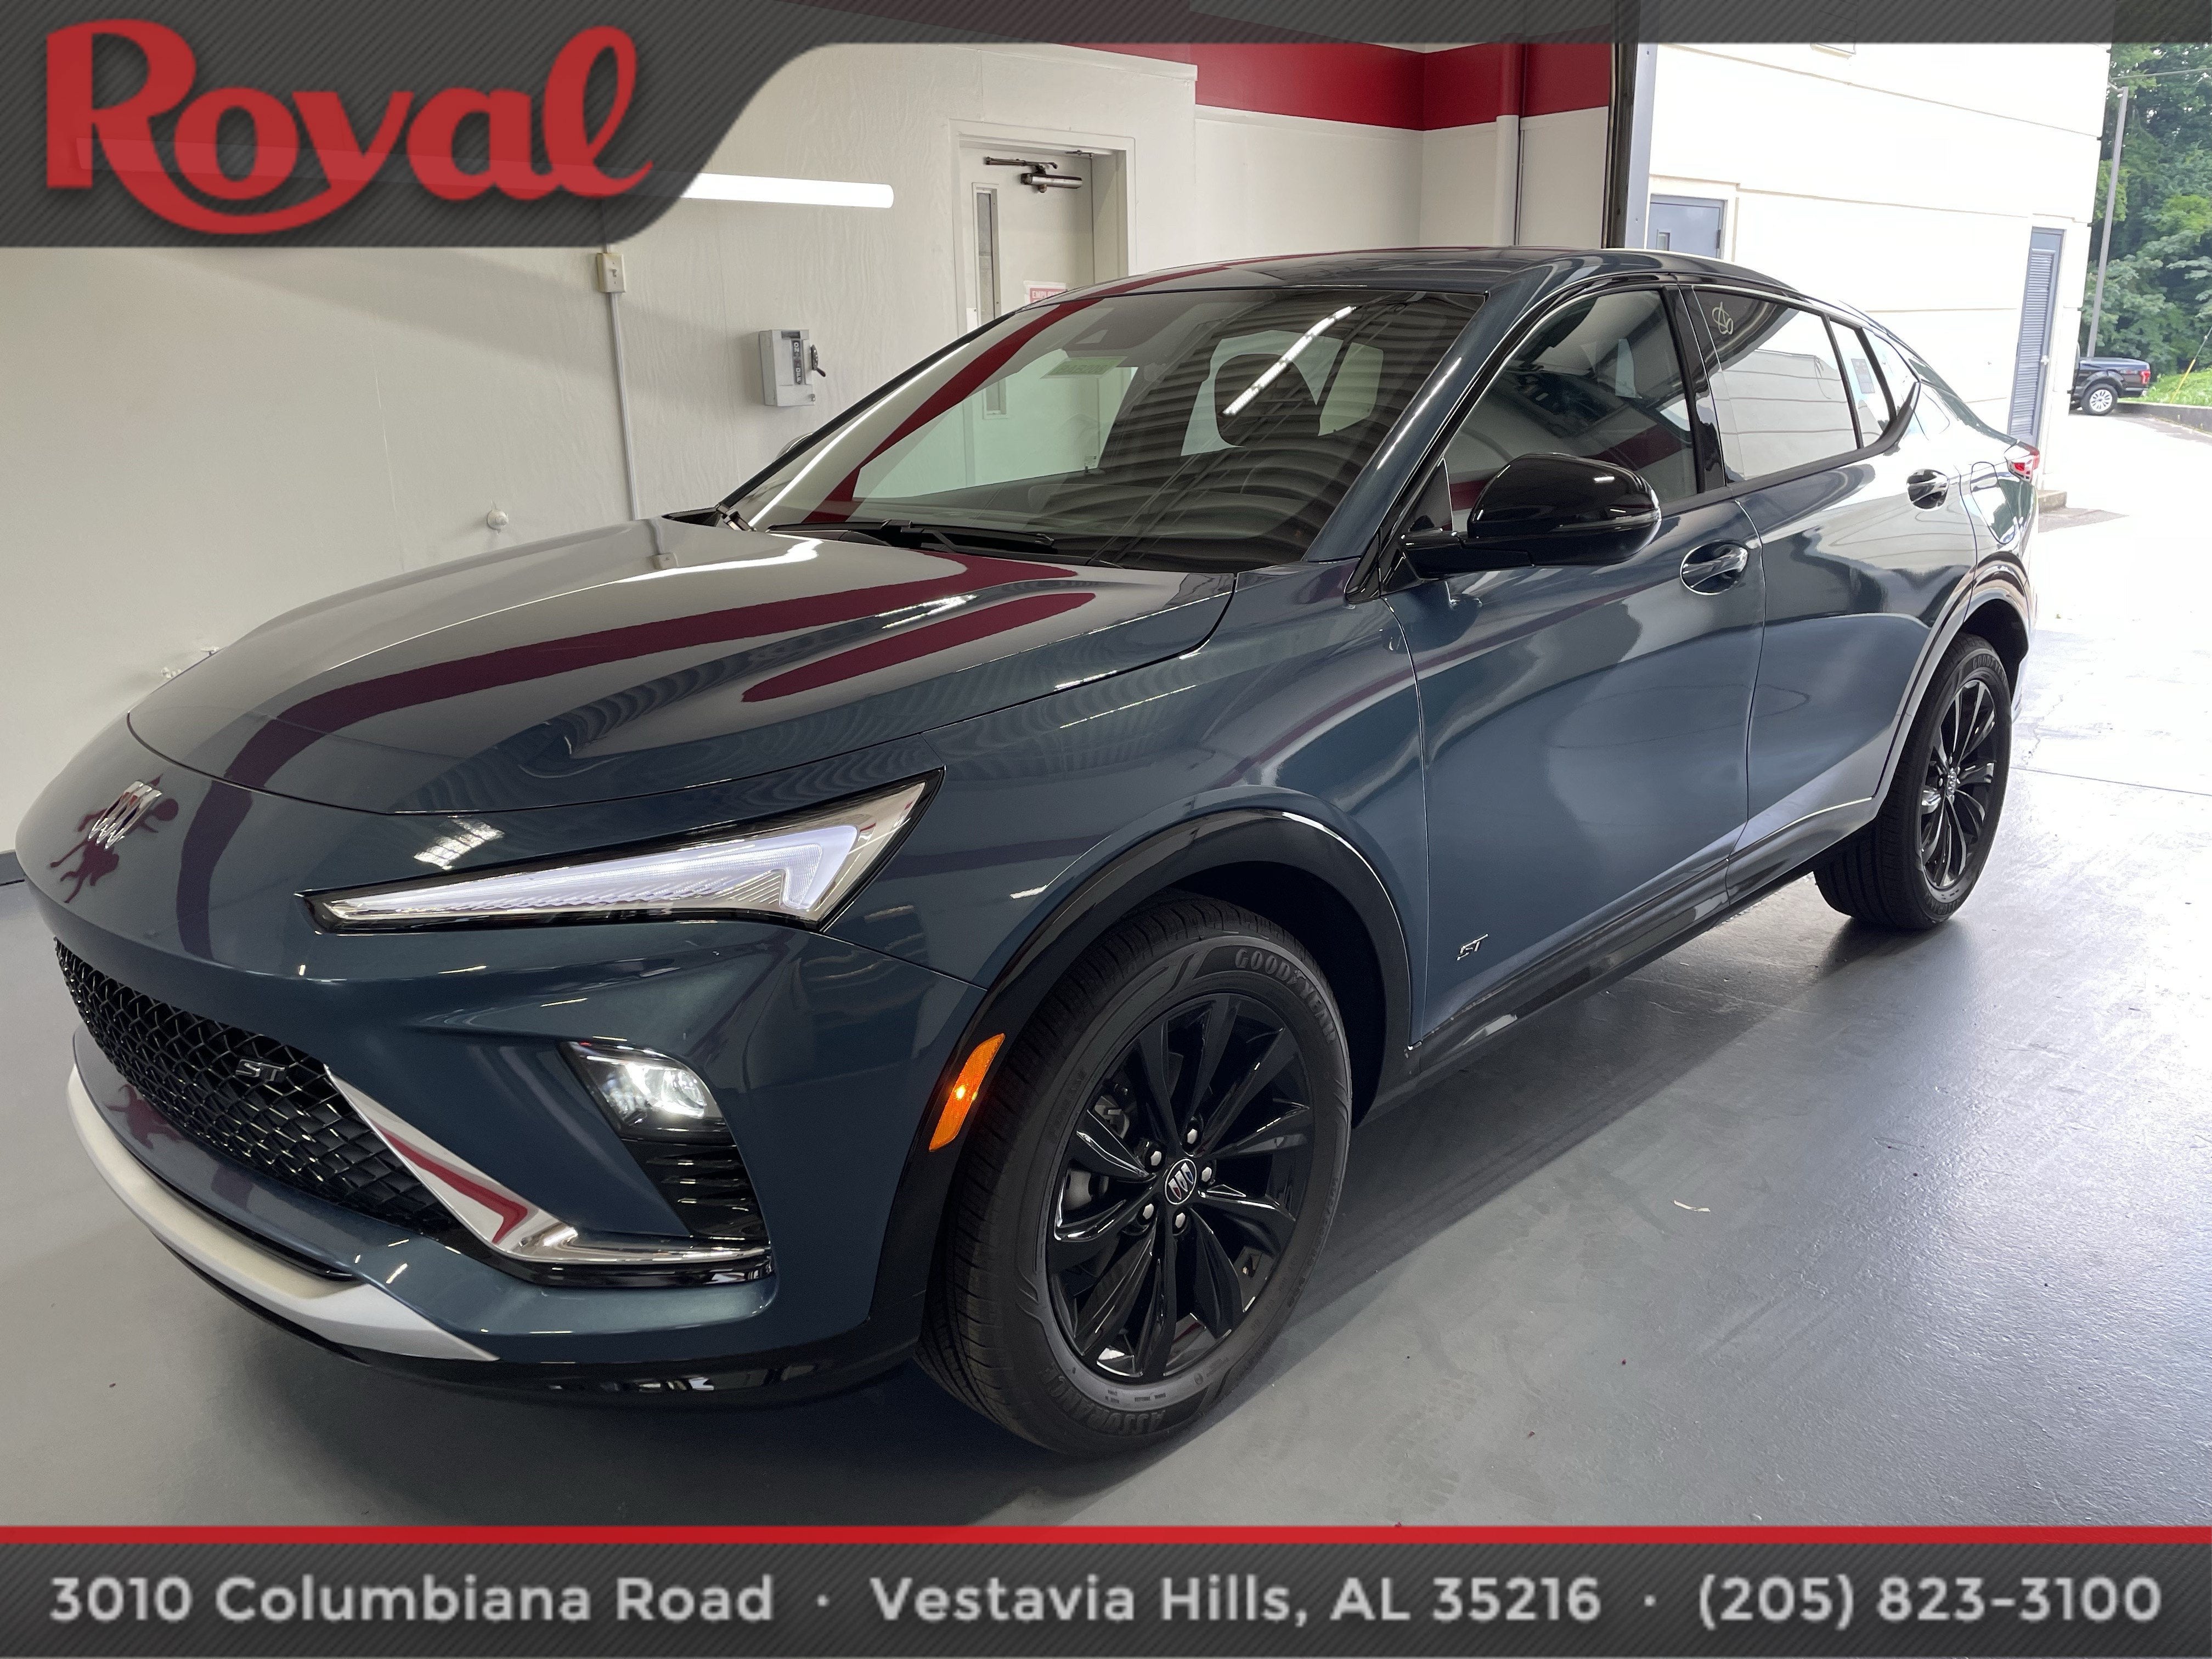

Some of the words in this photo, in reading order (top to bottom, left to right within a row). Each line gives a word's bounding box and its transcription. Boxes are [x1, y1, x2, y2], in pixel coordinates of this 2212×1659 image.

[794, 342, 799, 353] ON
[1457, 933, 1489, 961] ST
[1234, 947, 1337, 1042] GOODYEAR
[235, 1059, 285, 1081] ST
